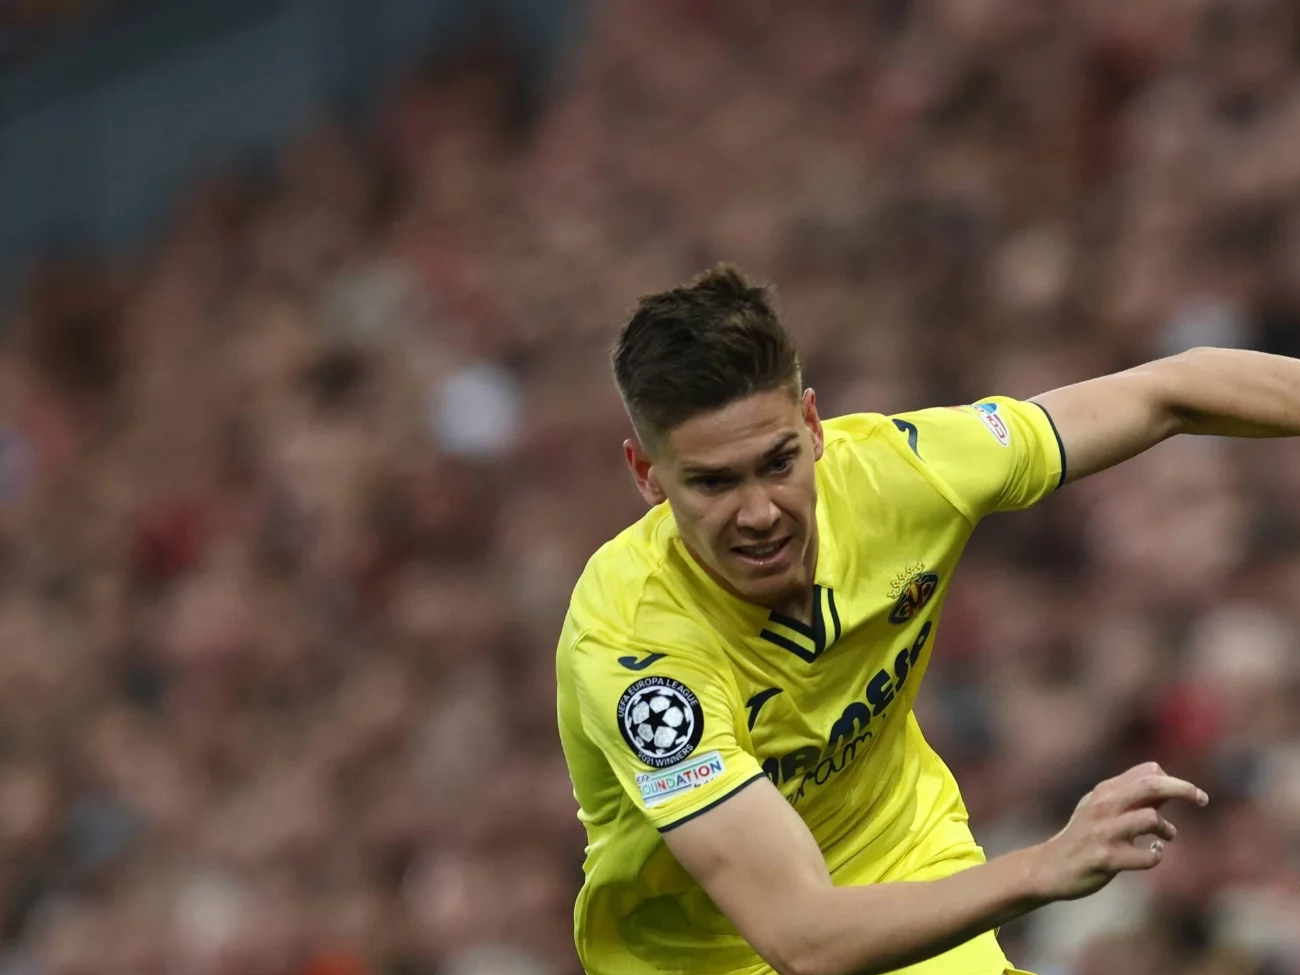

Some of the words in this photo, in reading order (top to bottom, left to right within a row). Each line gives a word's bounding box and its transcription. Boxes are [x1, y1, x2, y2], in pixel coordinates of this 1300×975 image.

[618, 694, 630, 717] UEFA
[629, 677, 664, 695] EUROPA
[666, 679, 698, 706] LEAGUE
[638, 751, 654, 766] 2021
[655, 744, 694, 767] WINNERS
[639, 760, 722, 796] OUNDATION
